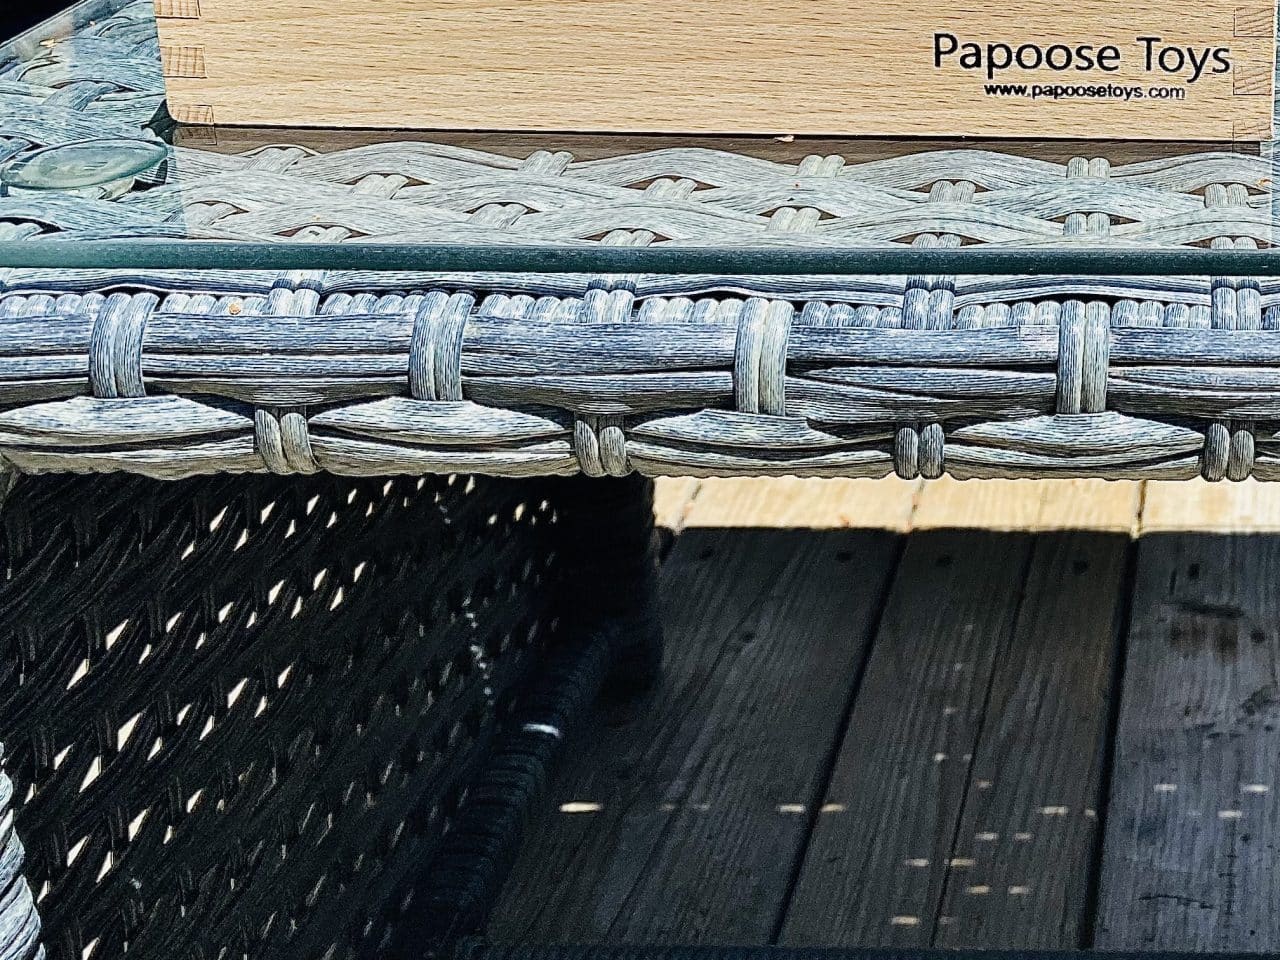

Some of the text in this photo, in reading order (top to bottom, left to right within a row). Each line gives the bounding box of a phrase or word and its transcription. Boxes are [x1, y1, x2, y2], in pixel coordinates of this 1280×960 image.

[933, 32, 1231, 84] Papoose Toys
[983, 82, 1186, 101] www.papoosetoys.com
